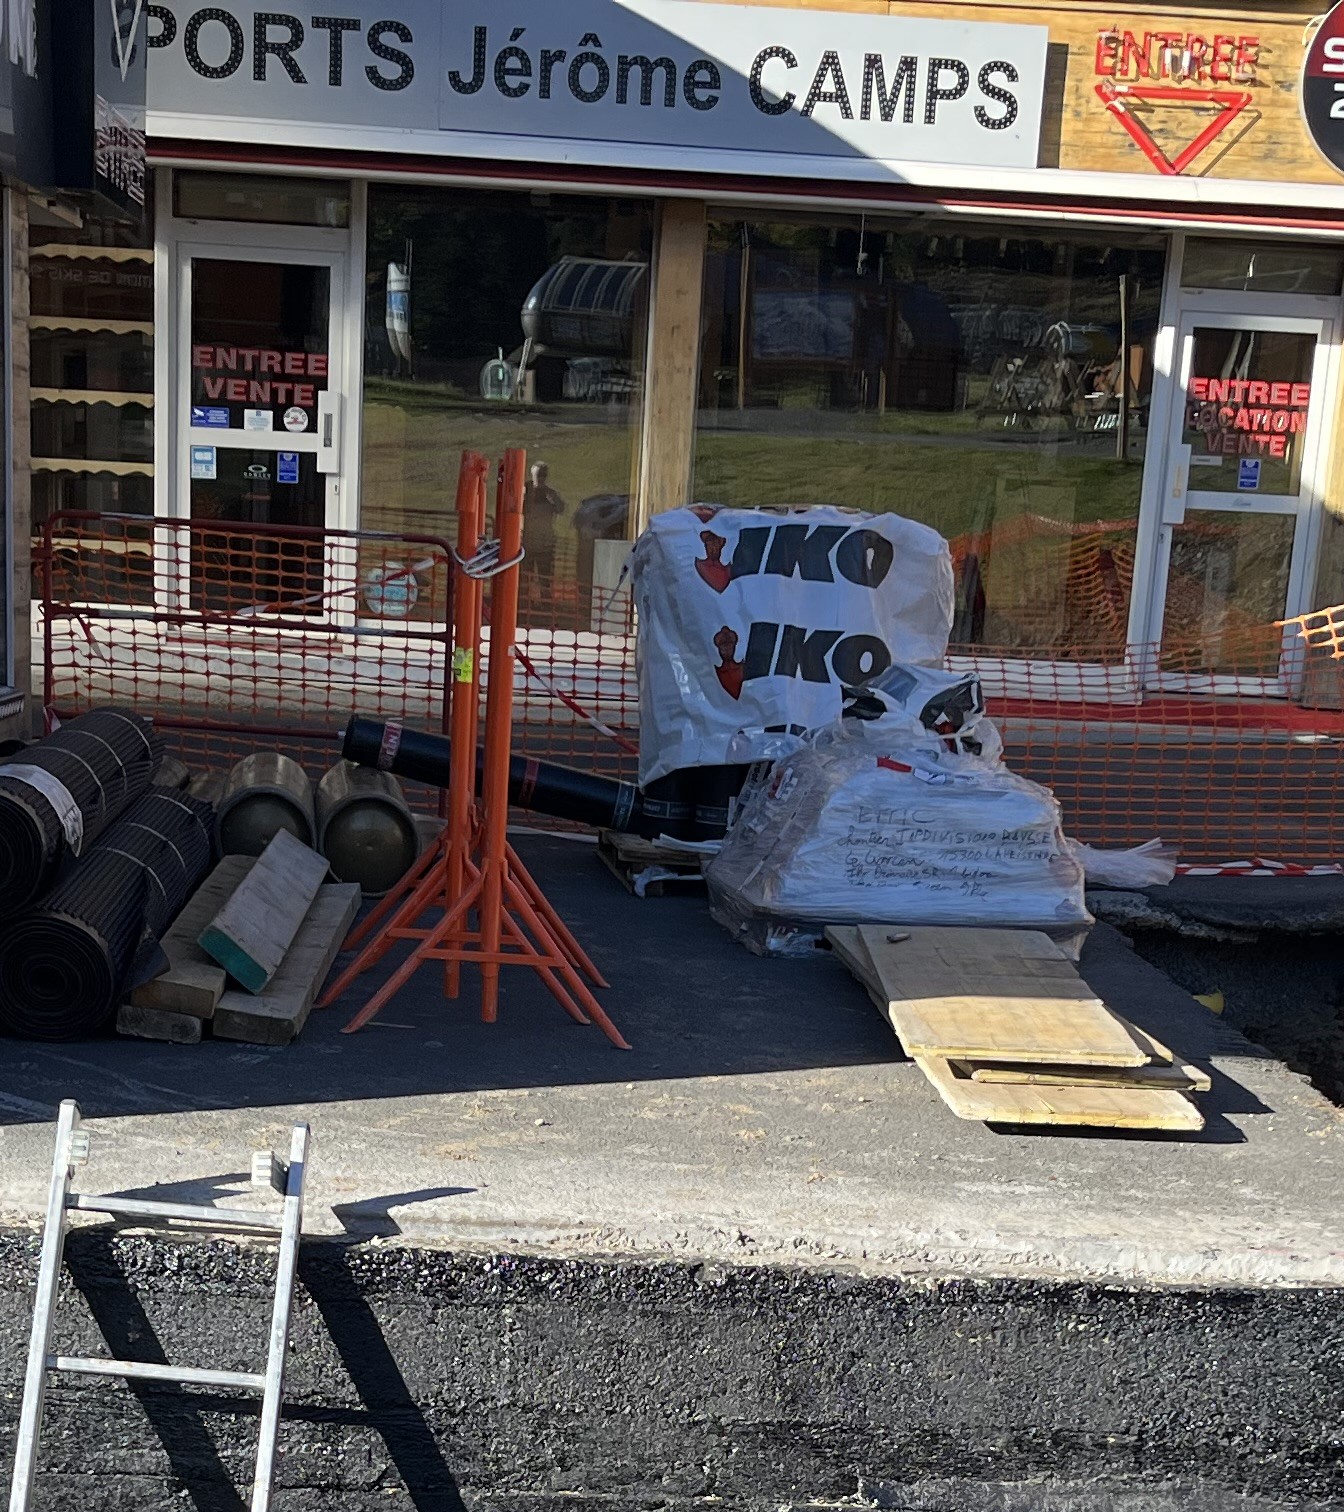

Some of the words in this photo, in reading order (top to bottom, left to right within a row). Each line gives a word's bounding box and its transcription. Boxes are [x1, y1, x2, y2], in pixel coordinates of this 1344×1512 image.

[1094, 28, 1260, 81] ENTREE
[447, 25, 722, 111] Jérôme
[748, 45, 1020, 131] CAMPS
[191, 344, 328, 377] ENTREE
[202, 376, 315, 407] VENTE
[1187, 377, 1311, 406] ENTREE
[1186, 404, 1306, 433] LOCATION
[1205, 431, 1288, 457] VENTE
[729, 524, 894, 589] IKO
[742, 621, 892, 687] IKO
